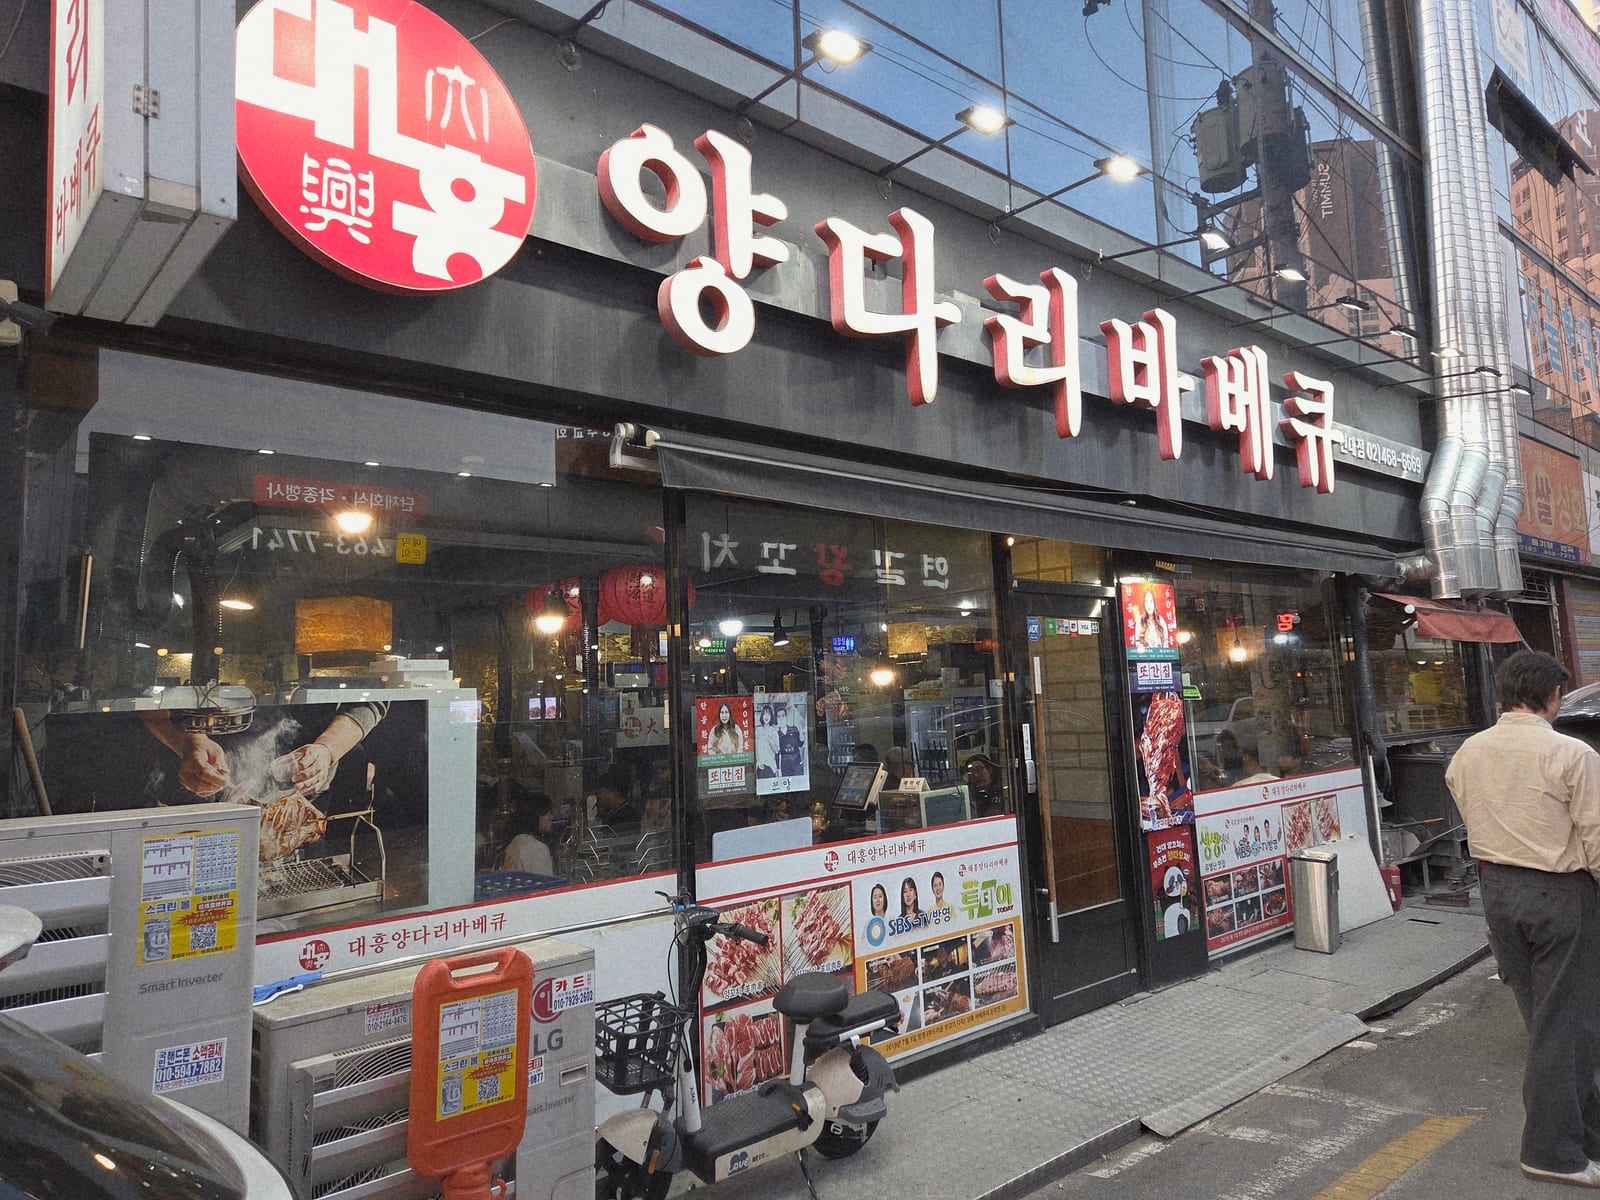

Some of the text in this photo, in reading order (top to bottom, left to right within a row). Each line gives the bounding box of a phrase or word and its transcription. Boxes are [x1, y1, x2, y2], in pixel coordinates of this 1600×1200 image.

[598, 122, 1335, 495] 양다리바베큐
[1139, 664, 1170, 678] 또간집
[709, 767, 744, 783] 또간집
[847, 839, 926, 864] 대흥양다리바베큐
[145, 902, 177, 914] 스크린
[348, 912, 507, 957] 대흥양다리바베큐
[140, 973, 223, 995] Smart Inverter
[533, 1029, 564, 1057] LG
[156, 1060, 222, 1083] 010-5947-7882
